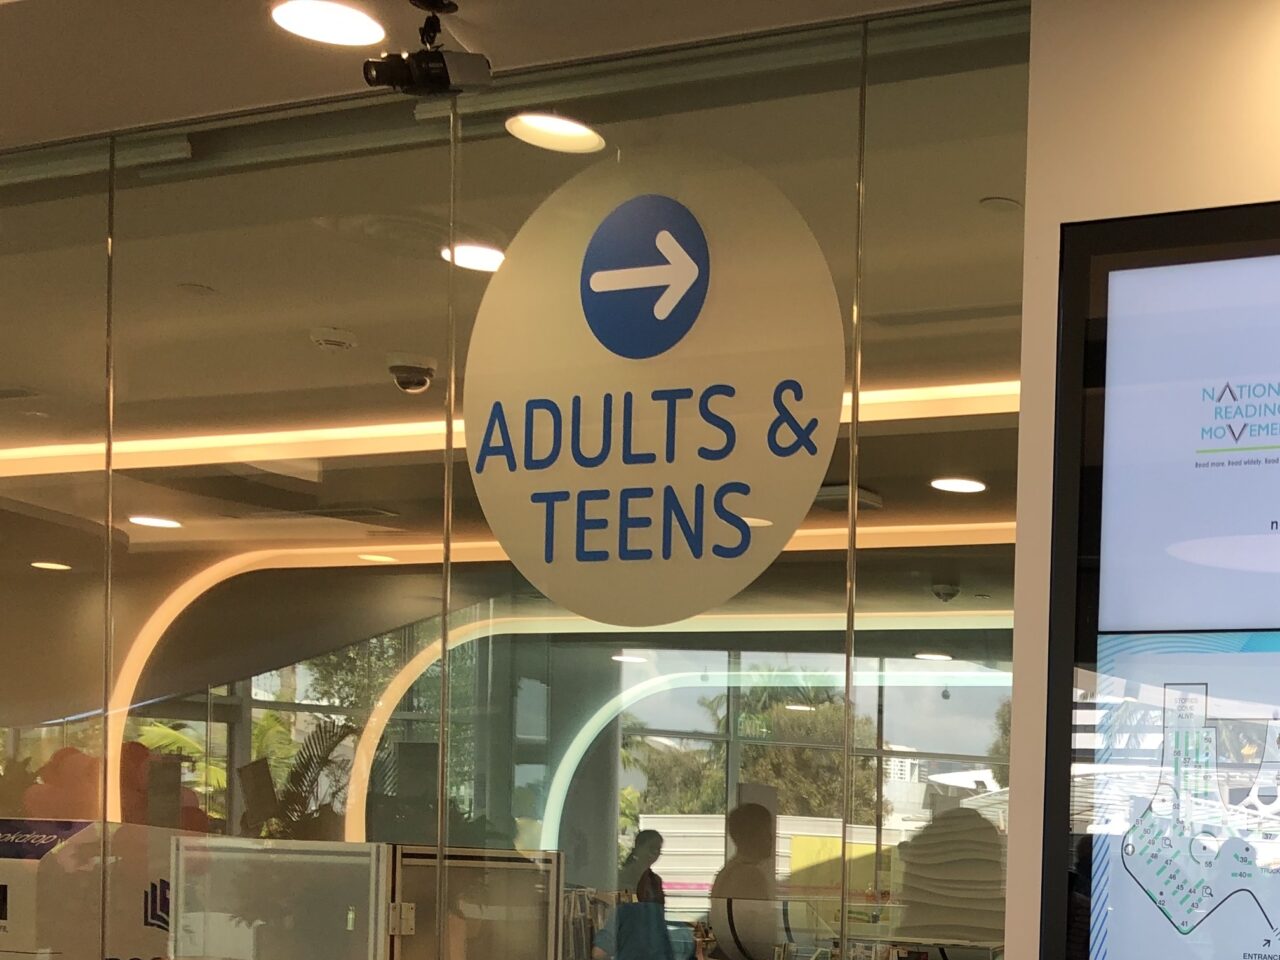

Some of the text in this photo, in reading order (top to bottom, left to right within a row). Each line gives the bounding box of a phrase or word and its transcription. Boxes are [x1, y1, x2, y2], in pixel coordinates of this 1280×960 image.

[474, 379, 819, 474] ADULTS &
[530, 482, 752, 563] TEENS
